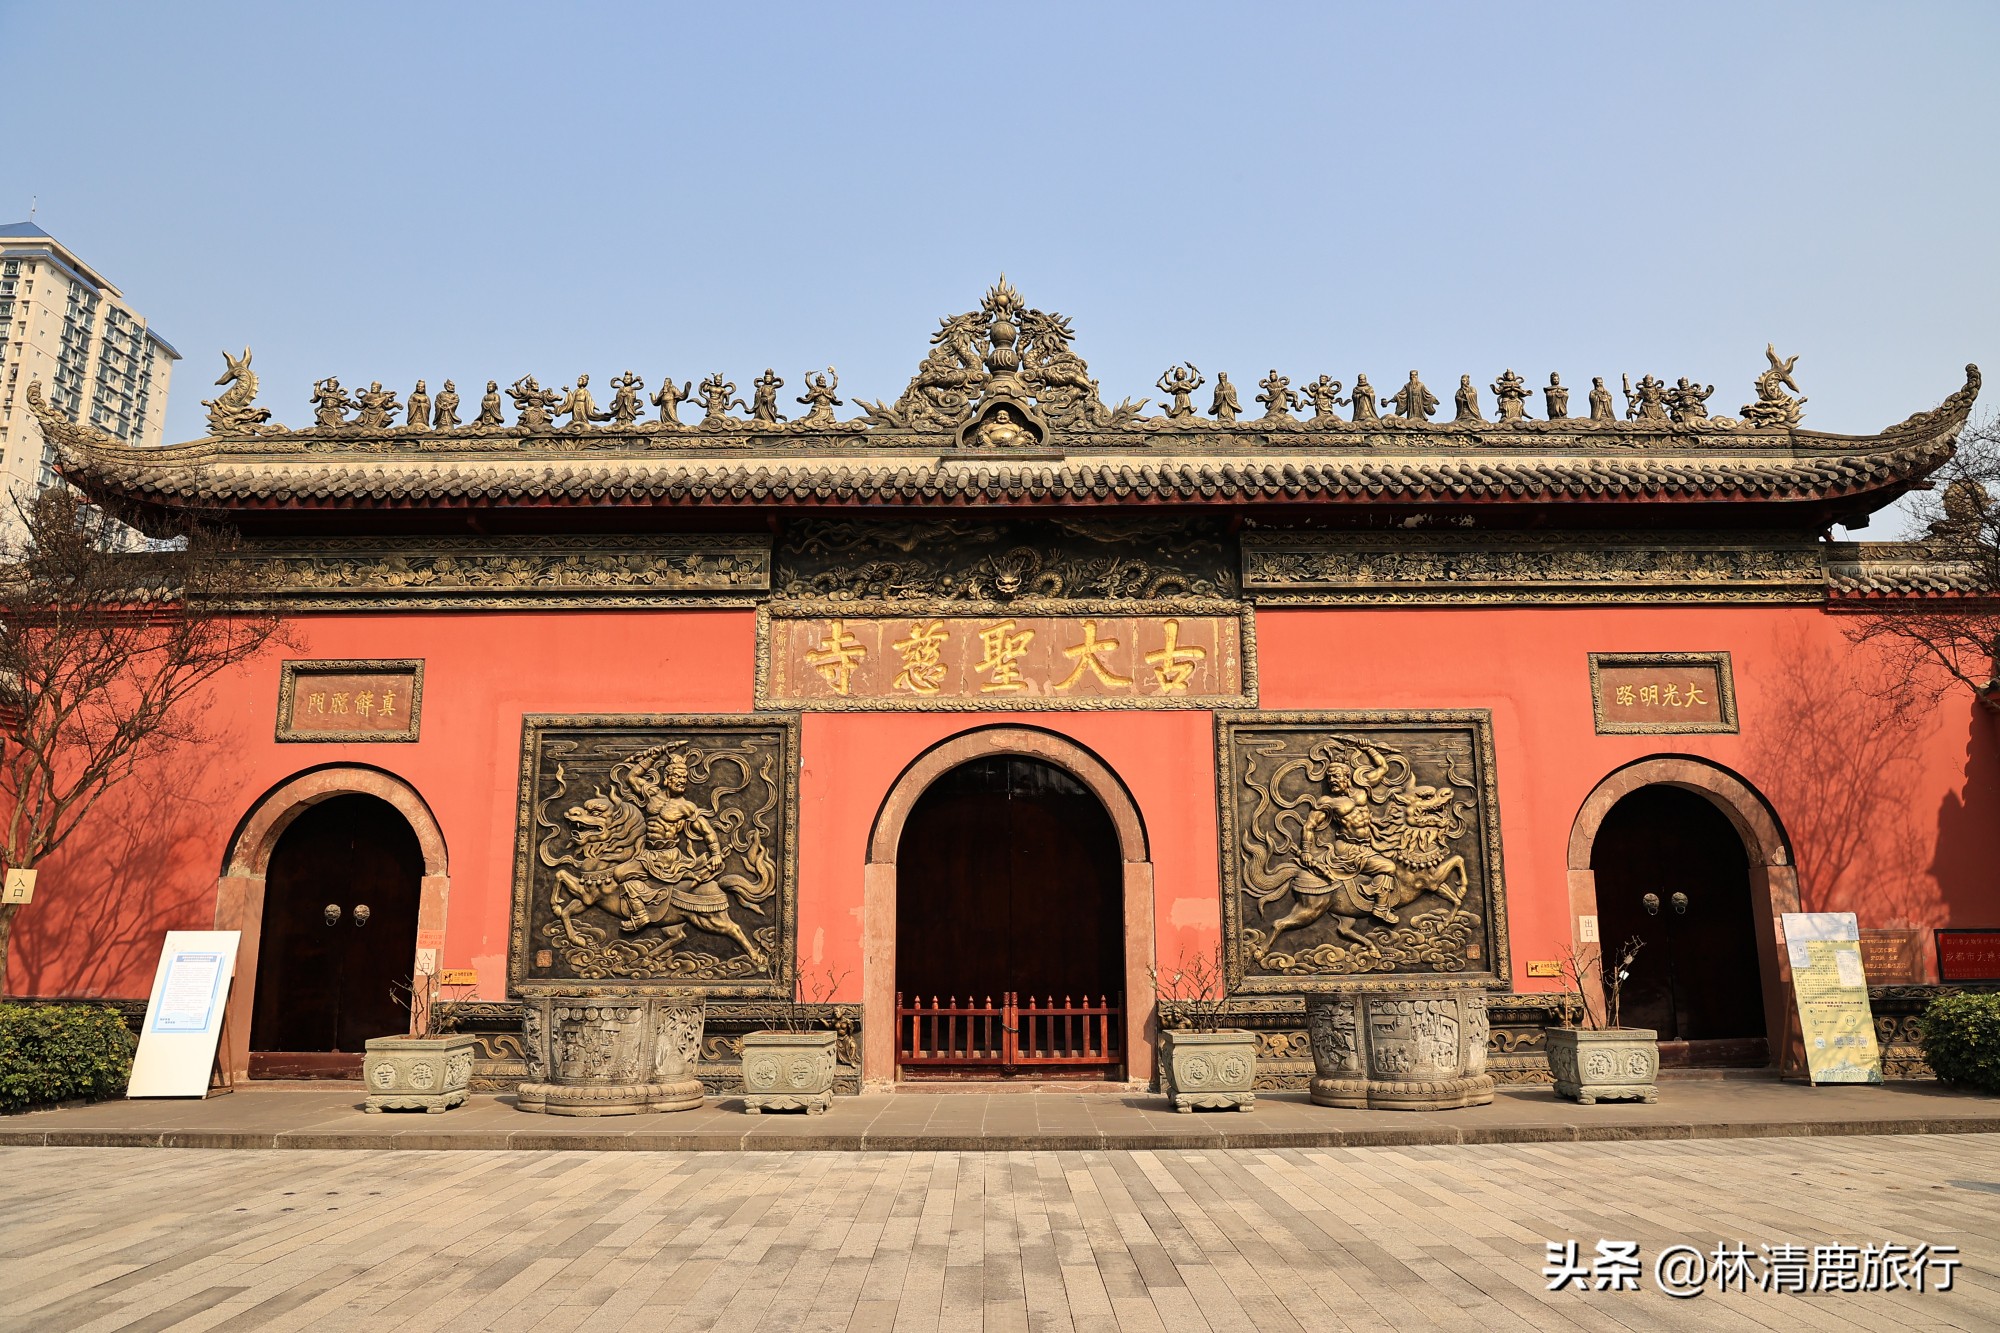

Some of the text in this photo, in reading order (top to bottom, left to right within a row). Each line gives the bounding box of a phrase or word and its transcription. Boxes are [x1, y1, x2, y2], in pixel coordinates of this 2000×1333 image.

[805, 618, 1208, 696] 古大聖慈寺
[1616, 682, 1708, 708] 大光明路
[13, 877, 26, 897] 入口
[1584, 919, 1594, 937] 出口
[422, 952, 431, 970] 入口
